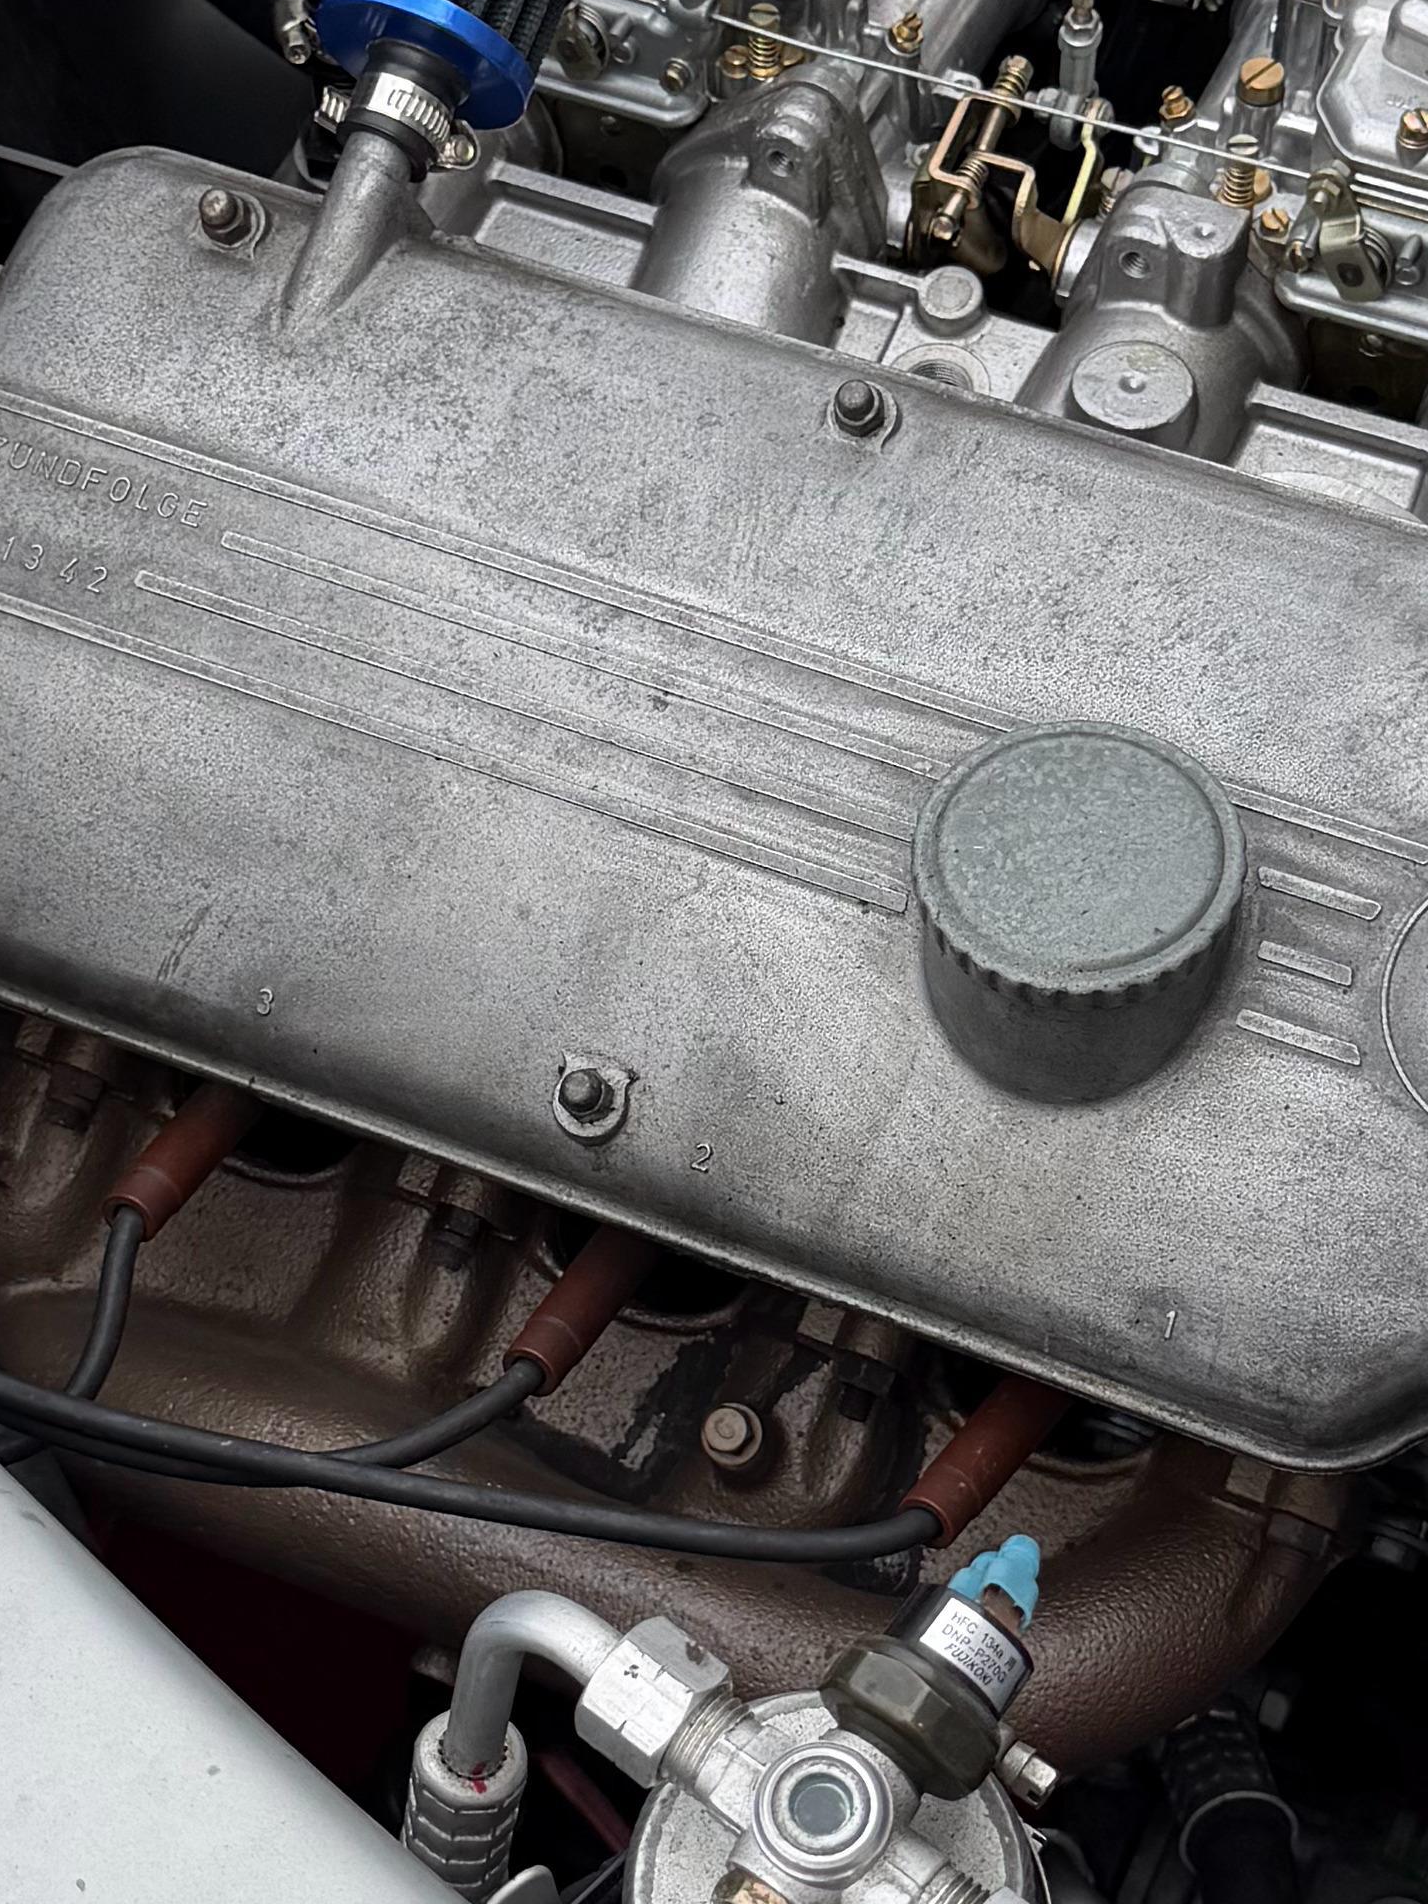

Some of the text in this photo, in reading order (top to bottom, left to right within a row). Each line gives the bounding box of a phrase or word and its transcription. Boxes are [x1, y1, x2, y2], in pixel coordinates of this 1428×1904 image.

[256, 987, 275, 1017] 3
[690, 1142, 714, 1174] 2
[1162, 1309, 1177, 1341] 1
[951, 1611, 979, 1635] HFC
[943, 1642, 993, 1686] FUJIKOKI
